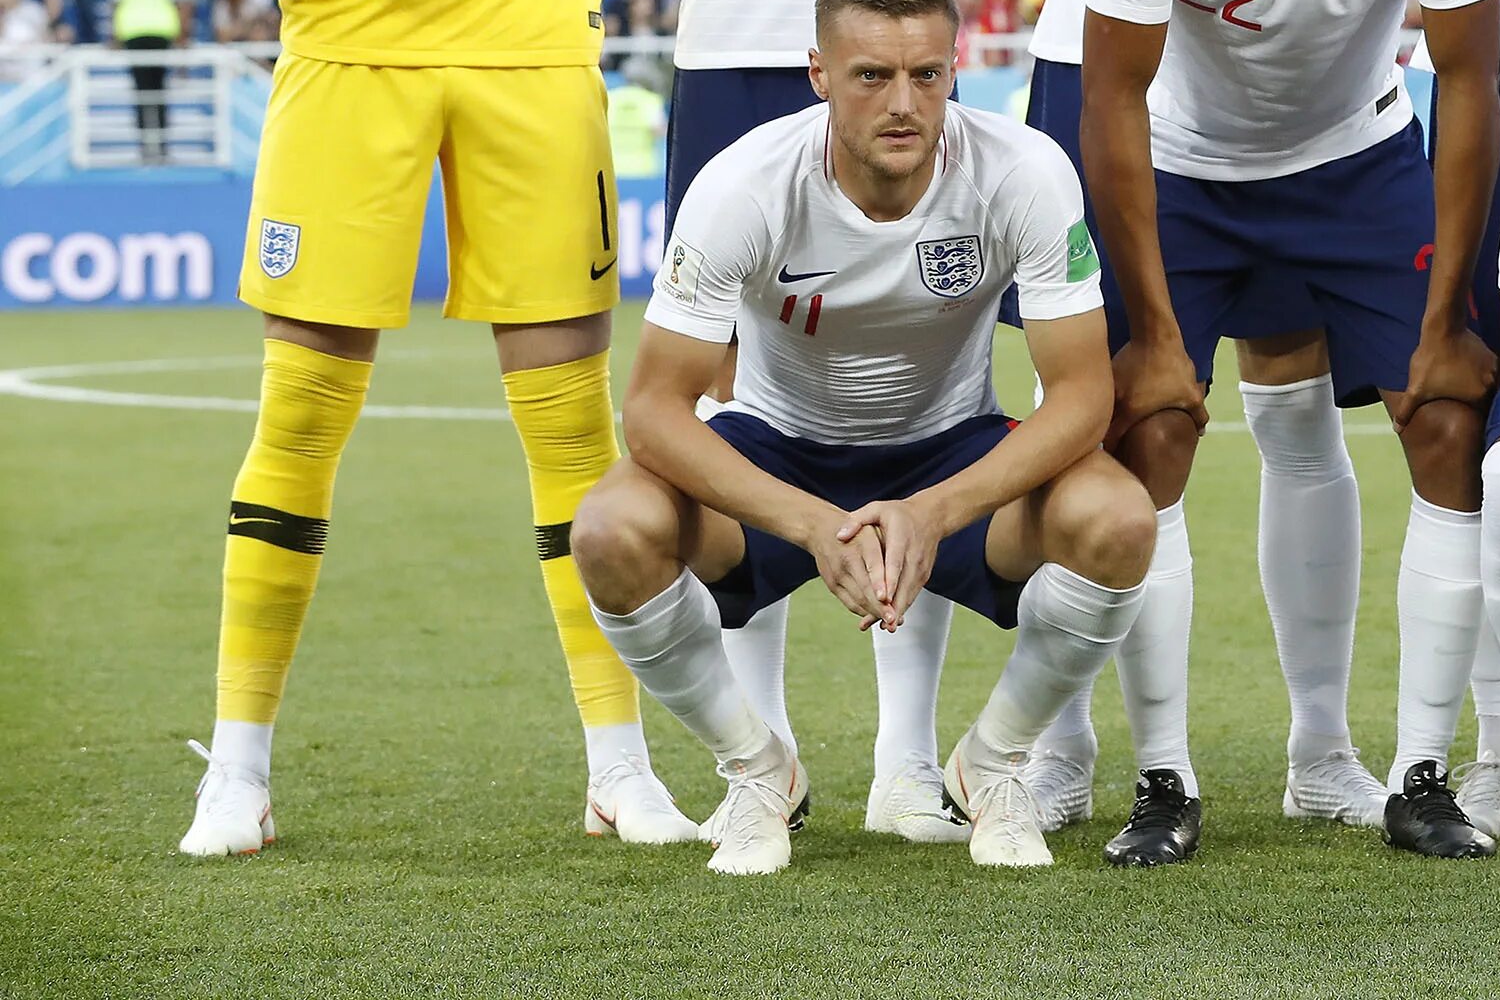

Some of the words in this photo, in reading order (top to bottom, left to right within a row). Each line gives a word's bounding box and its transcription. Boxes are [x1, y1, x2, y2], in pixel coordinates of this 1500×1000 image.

[597, 168, 611, 252] 1
[1, 231, 214, 302] com
[779, 292, 824, 337] 11
